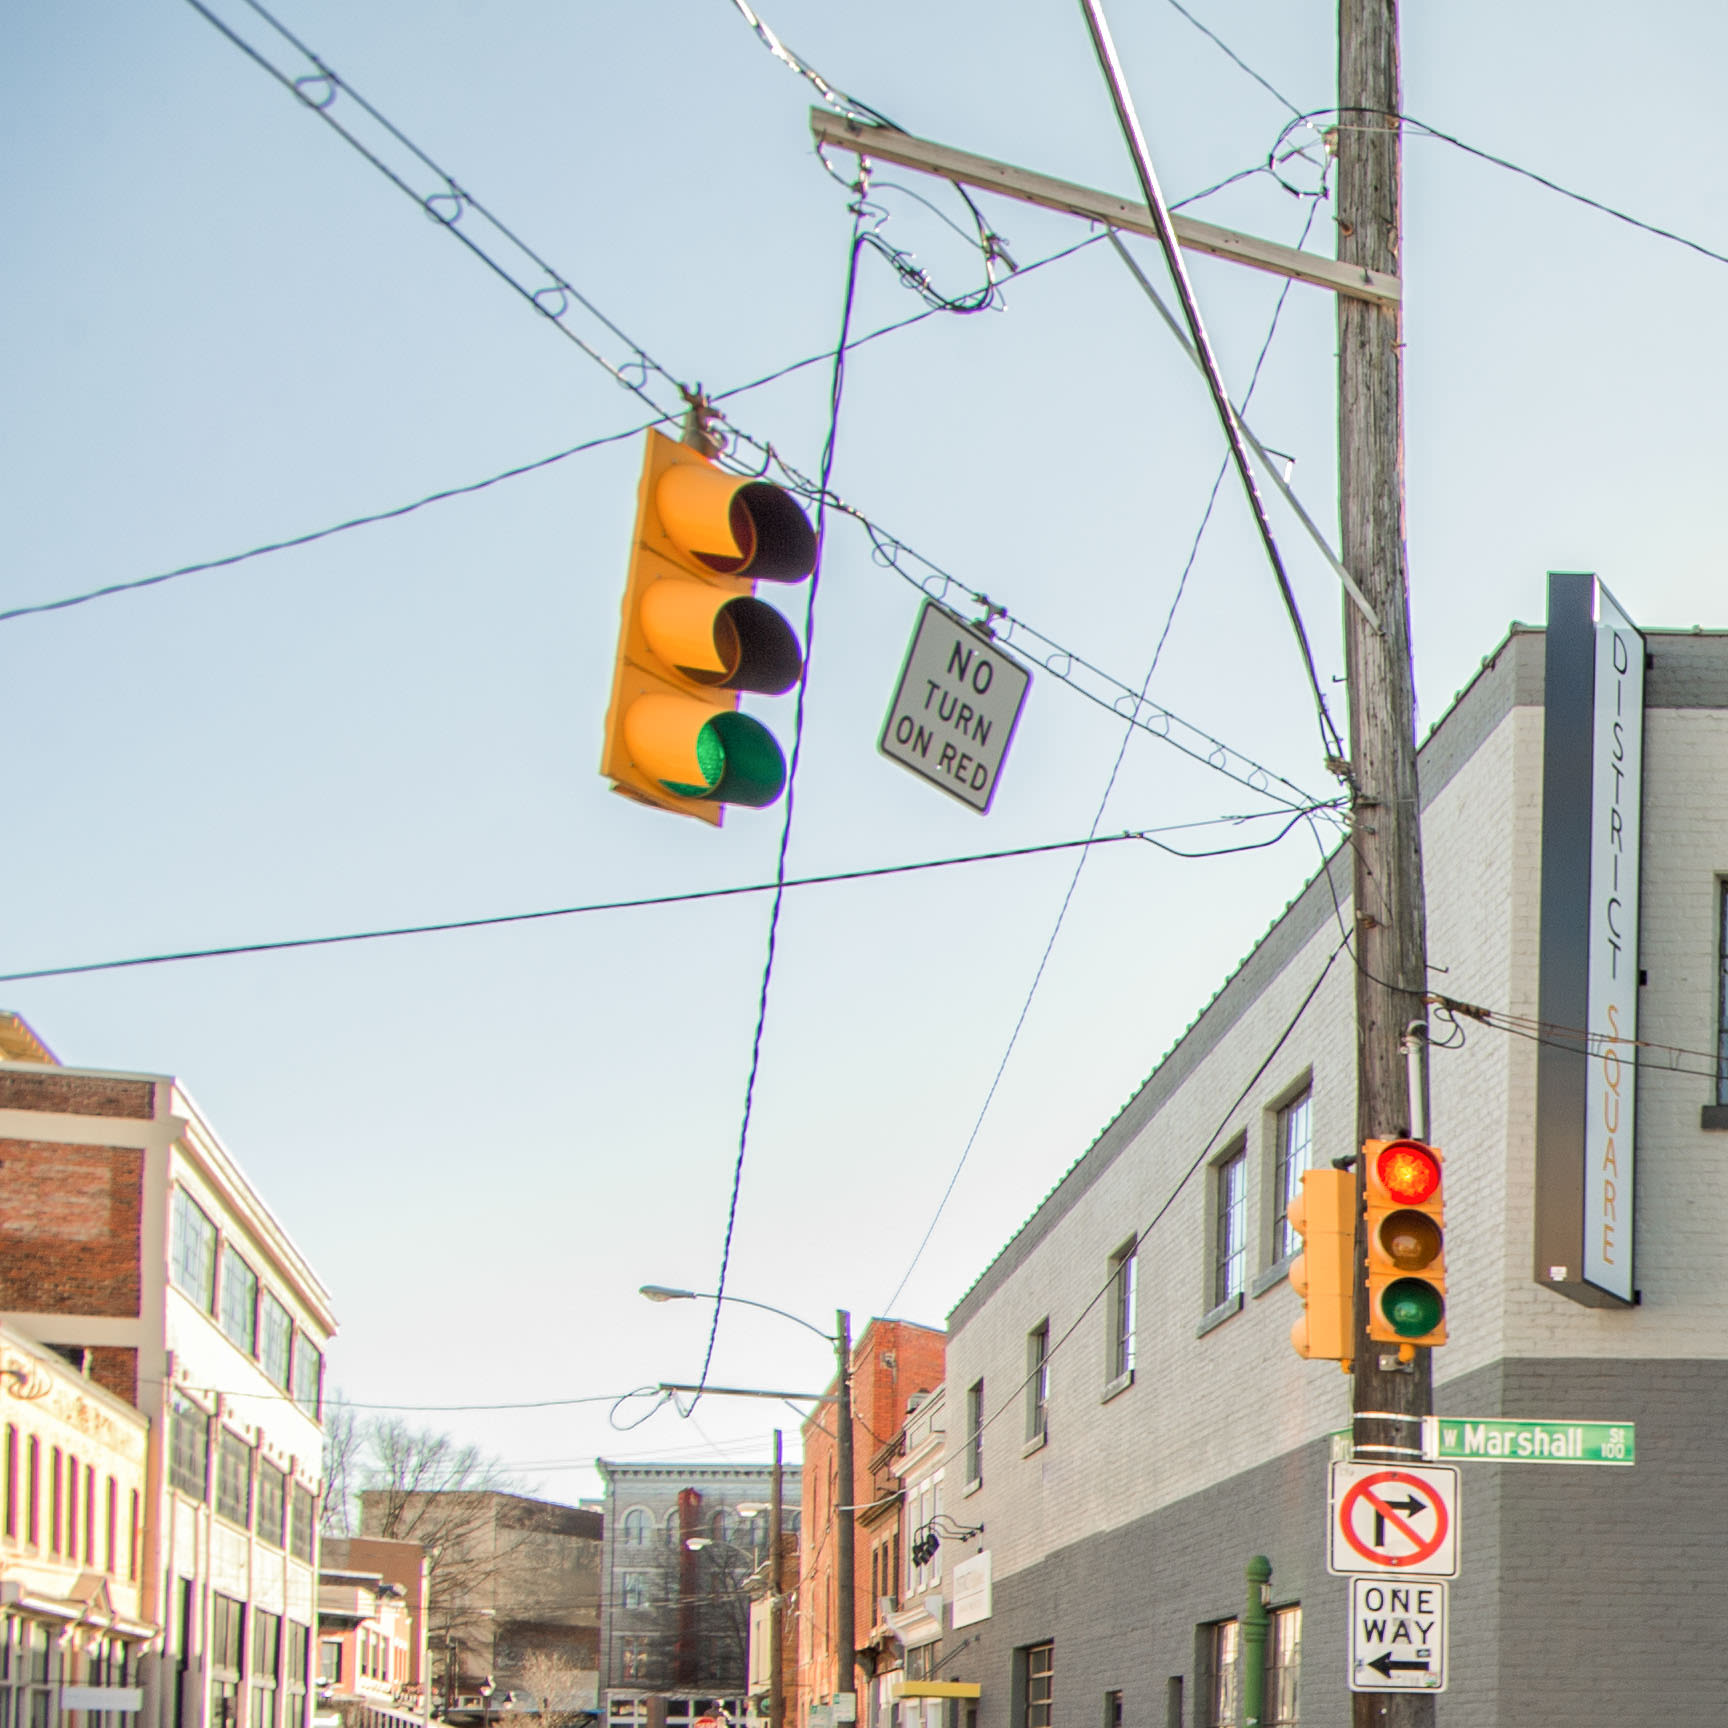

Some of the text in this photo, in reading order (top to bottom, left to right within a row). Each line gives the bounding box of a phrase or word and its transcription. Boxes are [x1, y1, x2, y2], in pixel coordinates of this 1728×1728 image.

[947, 640, 993, 694] NO
[923, 678, 993, 747] TURN
[895, 715, 988, 791] ON RED
[1602, 631, 1628, 1266] DISTRICT SQUARE
[1443, 1423, 1626, 1458] W Marshall St
[1601, 1442, 1625, 1459] 100
[1365, 1587, 1434, 1614] ONE
[1363, 1619, 1435, 1645] WAY
